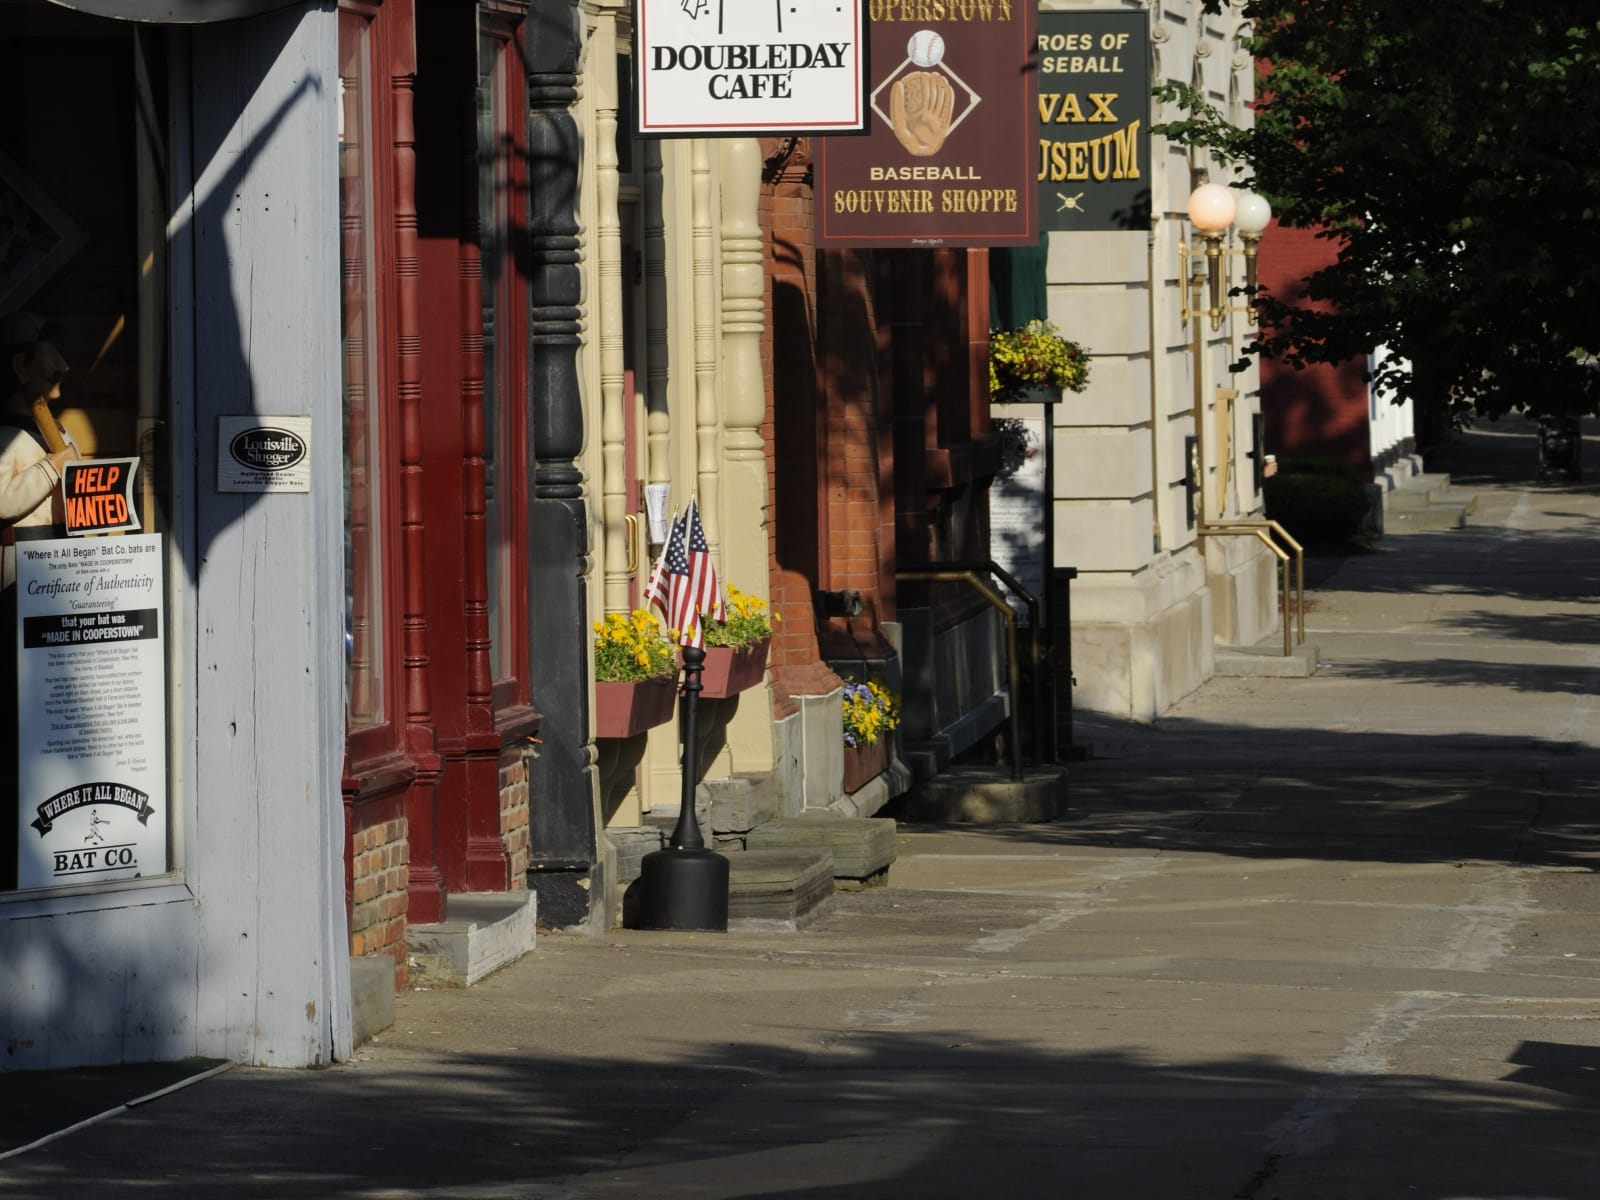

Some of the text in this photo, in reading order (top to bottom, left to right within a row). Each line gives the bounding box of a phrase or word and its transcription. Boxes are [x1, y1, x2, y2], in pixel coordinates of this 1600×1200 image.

[1100, 33, 1130, 51] OF
[651, 42, 852, 71] DOUBLEDAY
[870, 166, 982, 181] BASEBALL
[833, 188, 1018, 214] SOUVENIR SHOPPE
[243, 436, 299, 452] Louisville
[74, 466, 120, 493] HELP
[66, 493, 129, 529] WANTED
[61, 548, 71, 558] All
[101, 546, 114, 556] Bat
[128, 544, 144, 554] bats
[144, 544, 156, 553] are
[27, 573, 154, 599] Certificate of Authenticity
[62, 614, 126, 628] that your bat was
[72, 630, 81, 641] IN
[82, 787, 93, 803] IT
[94, 785, 113, 800] ALL
[53, 847, 138, 872] BAT CO.
